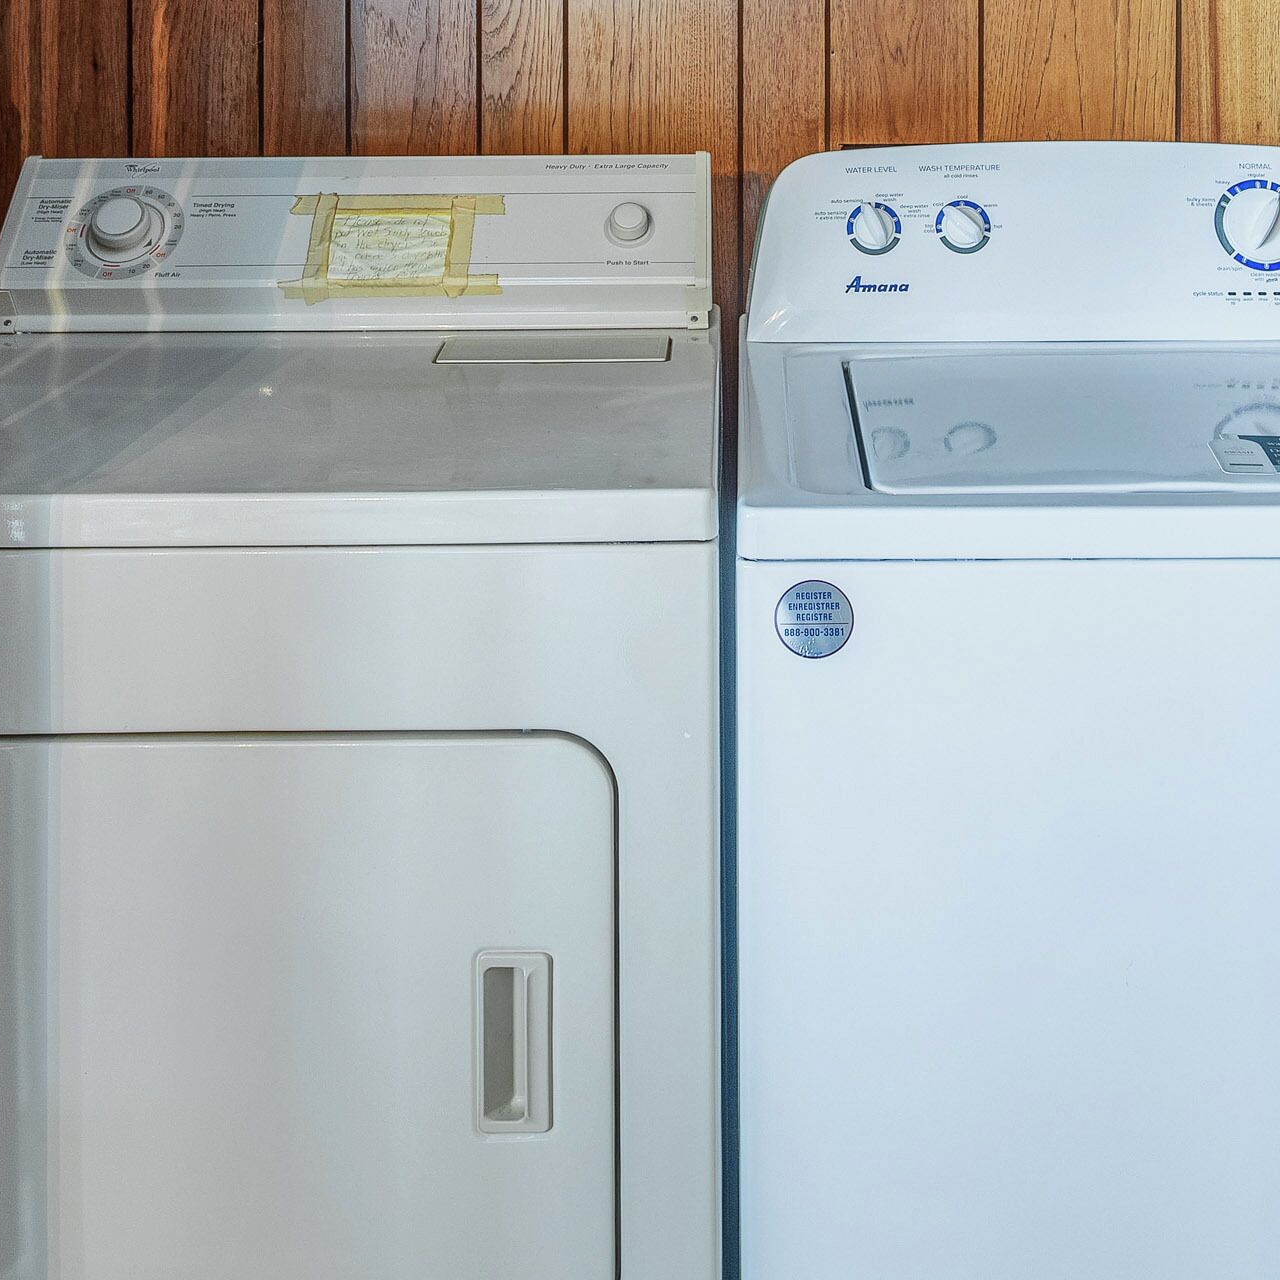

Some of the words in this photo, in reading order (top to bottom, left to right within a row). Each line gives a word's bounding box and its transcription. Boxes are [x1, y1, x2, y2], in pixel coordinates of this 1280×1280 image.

[124, 162, 160, 178] Whirlpool
[845, 276, 909, 293] Amana
[796, 592, 832, 600] REGISTER
[788, 602, 840, 611] ENREGISTRER
[796, 613, 832, 621] REGISTRE
[784, 628, 844, 637] 888-900-3381
